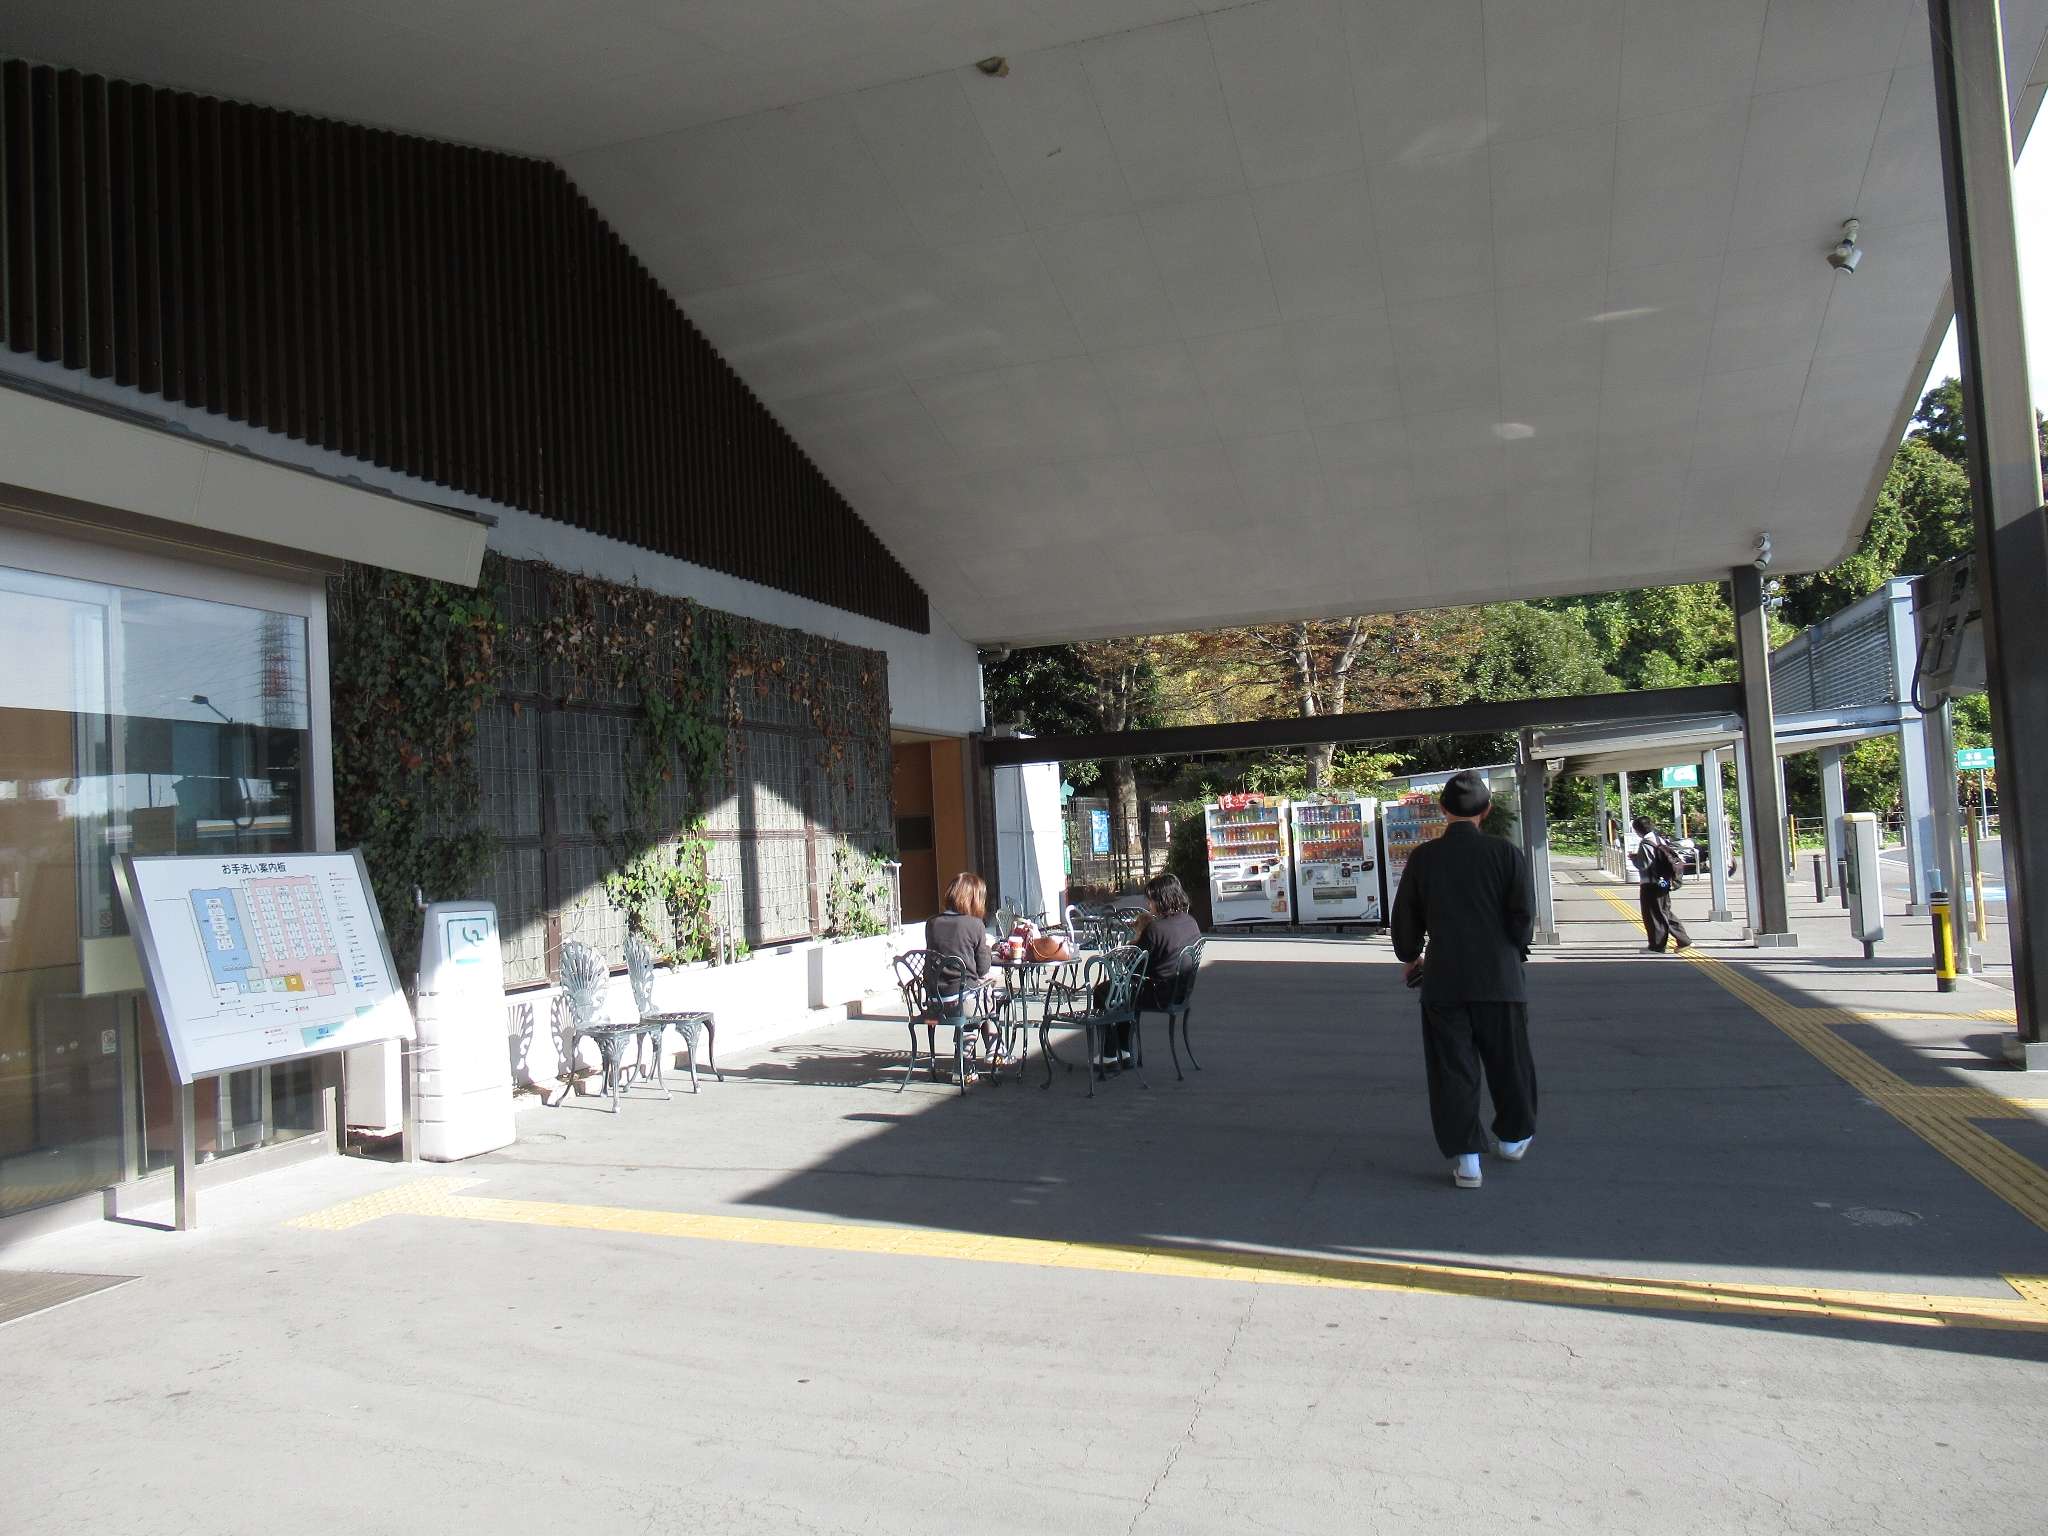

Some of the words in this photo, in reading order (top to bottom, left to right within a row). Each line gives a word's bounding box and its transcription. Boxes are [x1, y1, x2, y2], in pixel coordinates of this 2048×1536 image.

[221, 862, 287, 875] お手洗い案内板
